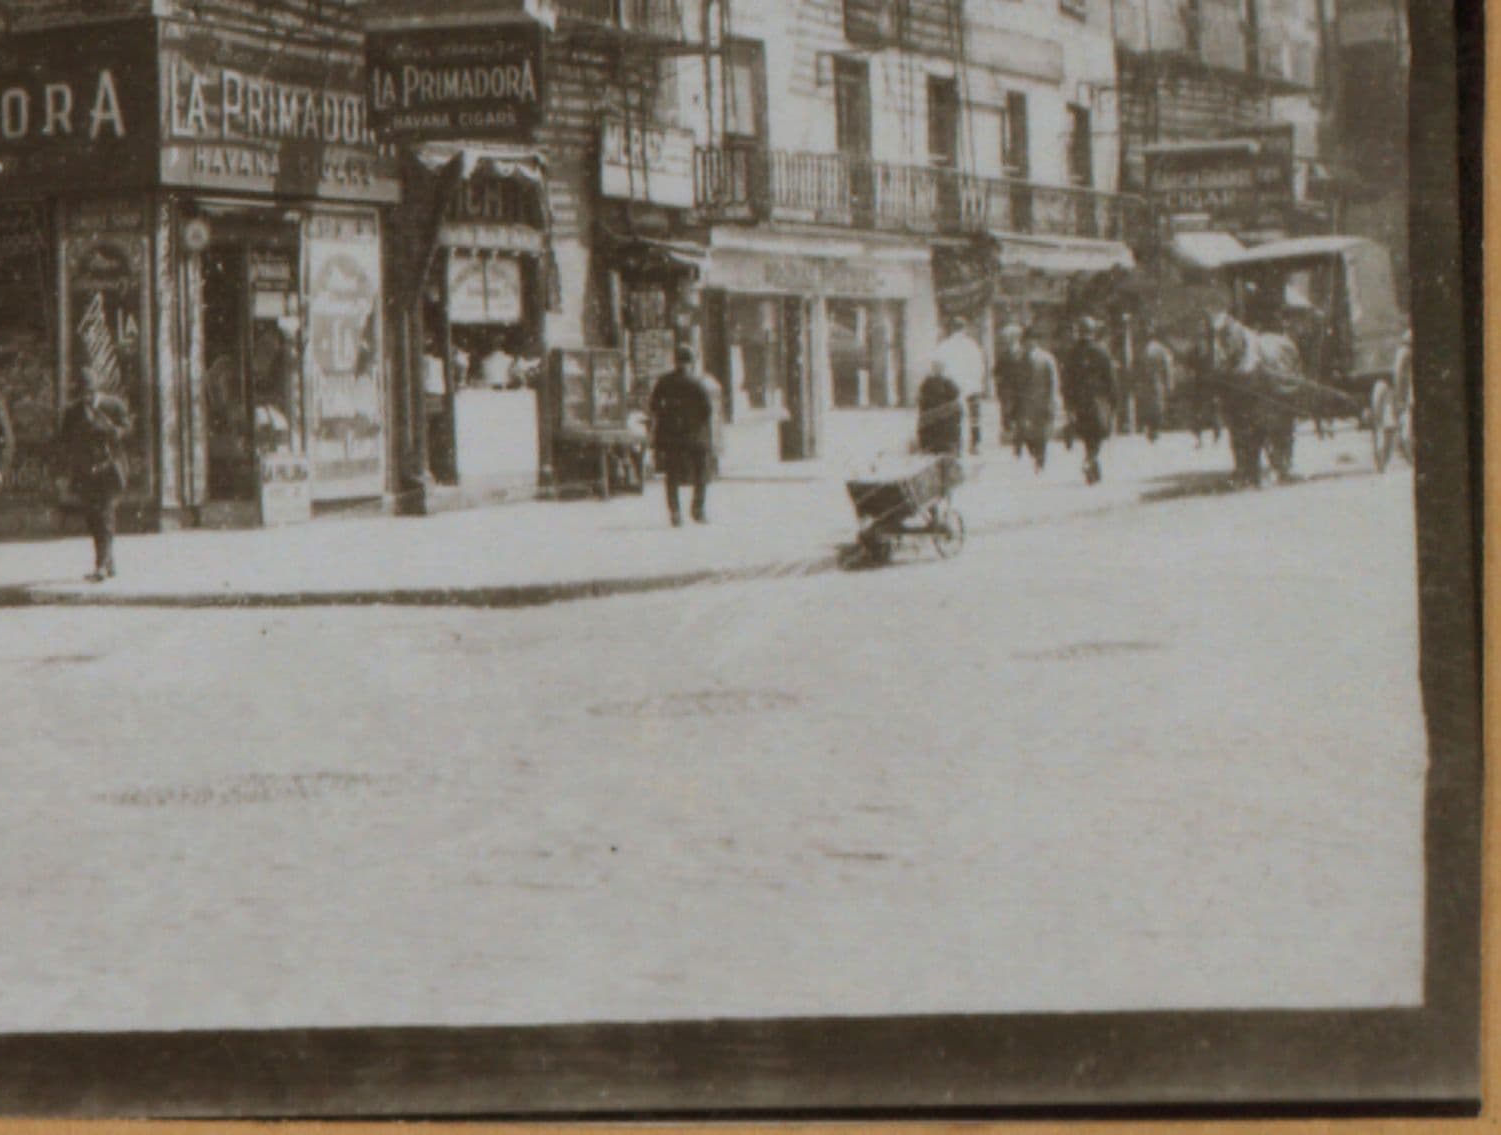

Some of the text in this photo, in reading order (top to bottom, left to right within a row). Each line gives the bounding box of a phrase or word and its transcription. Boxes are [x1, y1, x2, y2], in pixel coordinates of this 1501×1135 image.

[374, 59, 536, 110] LA PRIMADORA
[171, 59, 396, 158] LA PRIMADO
[393, 109, 516, 129] HAVANA CIGARS
[194, 144, 280, 179] HAVANA
[117, 306, 140, 345] LA
